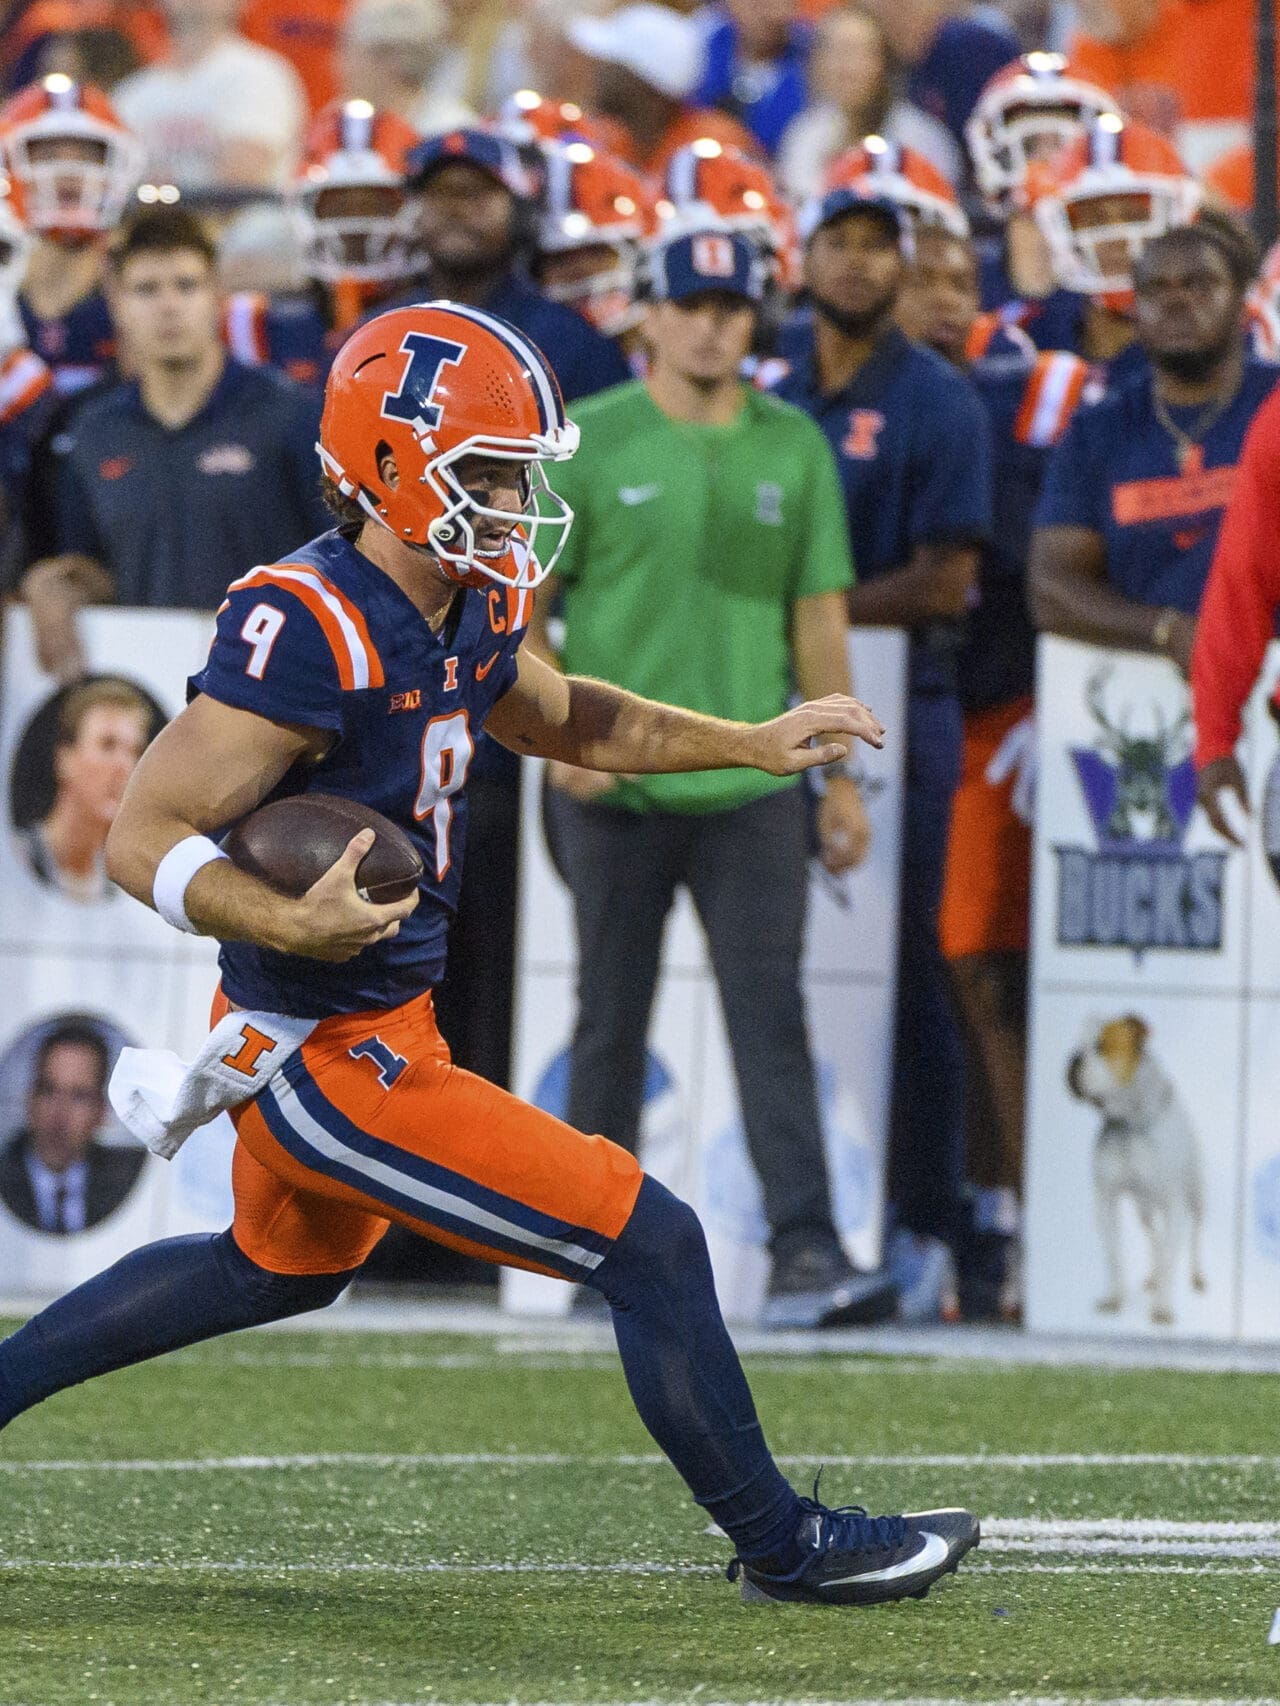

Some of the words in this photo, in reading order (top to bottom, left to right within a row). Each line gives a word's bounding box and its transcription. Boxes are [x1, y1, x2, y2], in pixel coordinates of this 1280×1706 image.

[380, 331, 468, 431] I
[239, 602, 287, 681] 9
[487, 588, 506, 634] C
[442, 655, 459, 692] I
[413, 707, 475, 884] 9
[1053, 850, 1228, 949] BUCKS
[221, 1023, 277, 1077] I
[348, 1034, 409, 1091] I
